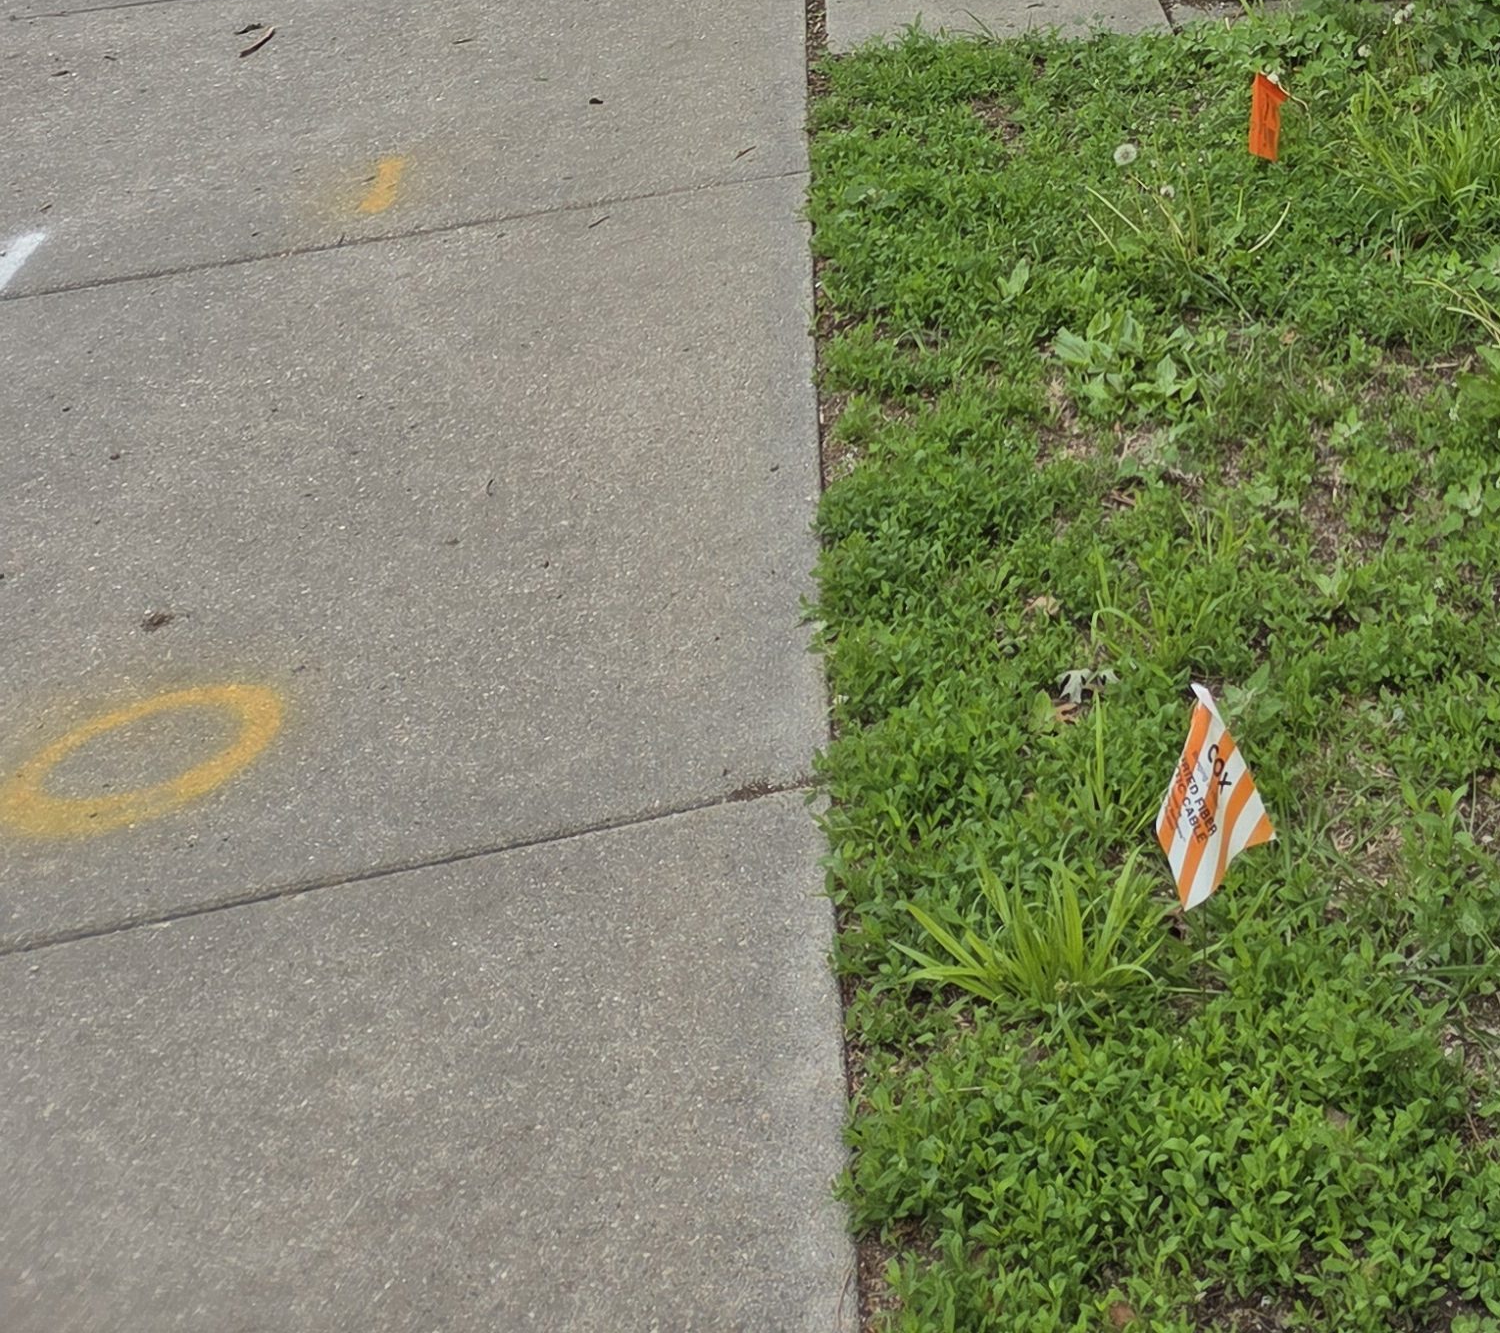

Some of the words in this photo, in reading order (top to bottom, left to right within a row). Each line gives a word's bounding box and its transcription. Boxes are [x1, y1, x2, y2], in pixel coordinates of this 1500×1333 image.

[1207, 744, 1232, 795] COX
[1181, 758, 1199, 795] RIED
[1194, 797, 1217, 836] FIBER
[1183, 797, 1208, 844] CABLE
